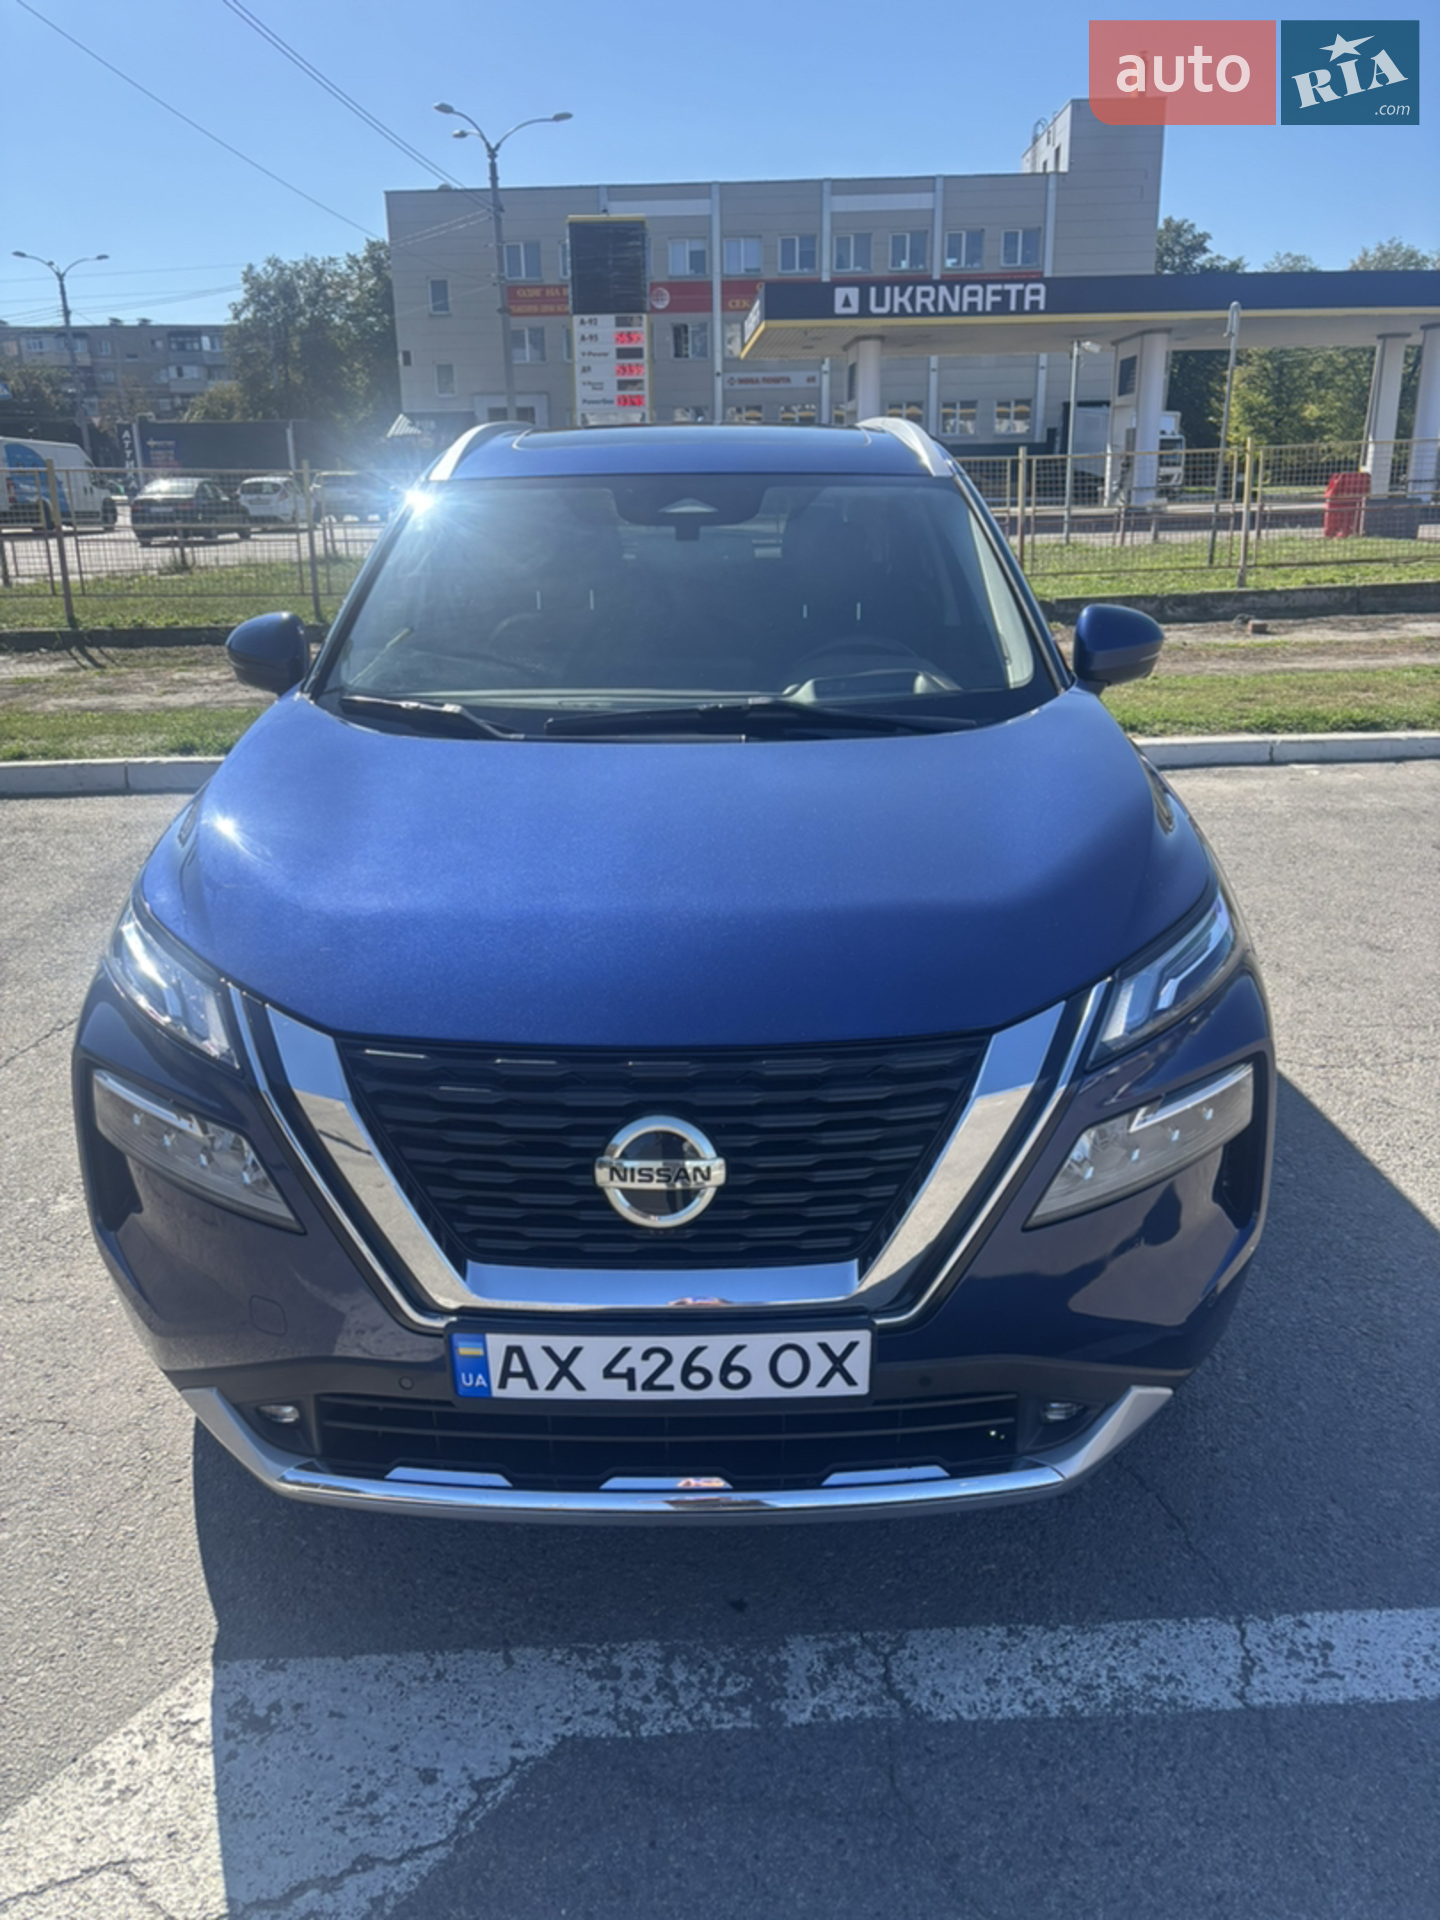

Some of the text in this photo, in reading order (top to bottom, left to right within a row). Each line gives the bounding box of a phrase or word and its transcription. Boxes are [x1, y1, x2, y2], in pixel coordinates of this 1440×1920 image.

[868, 283, 1046, 314] UKRNAFTA
[609, 1165, 712, 1184] NISSAN
[497, 1340, 861, 1392] AX 4266 OX
[461, 1372, 488, 1388] UA
